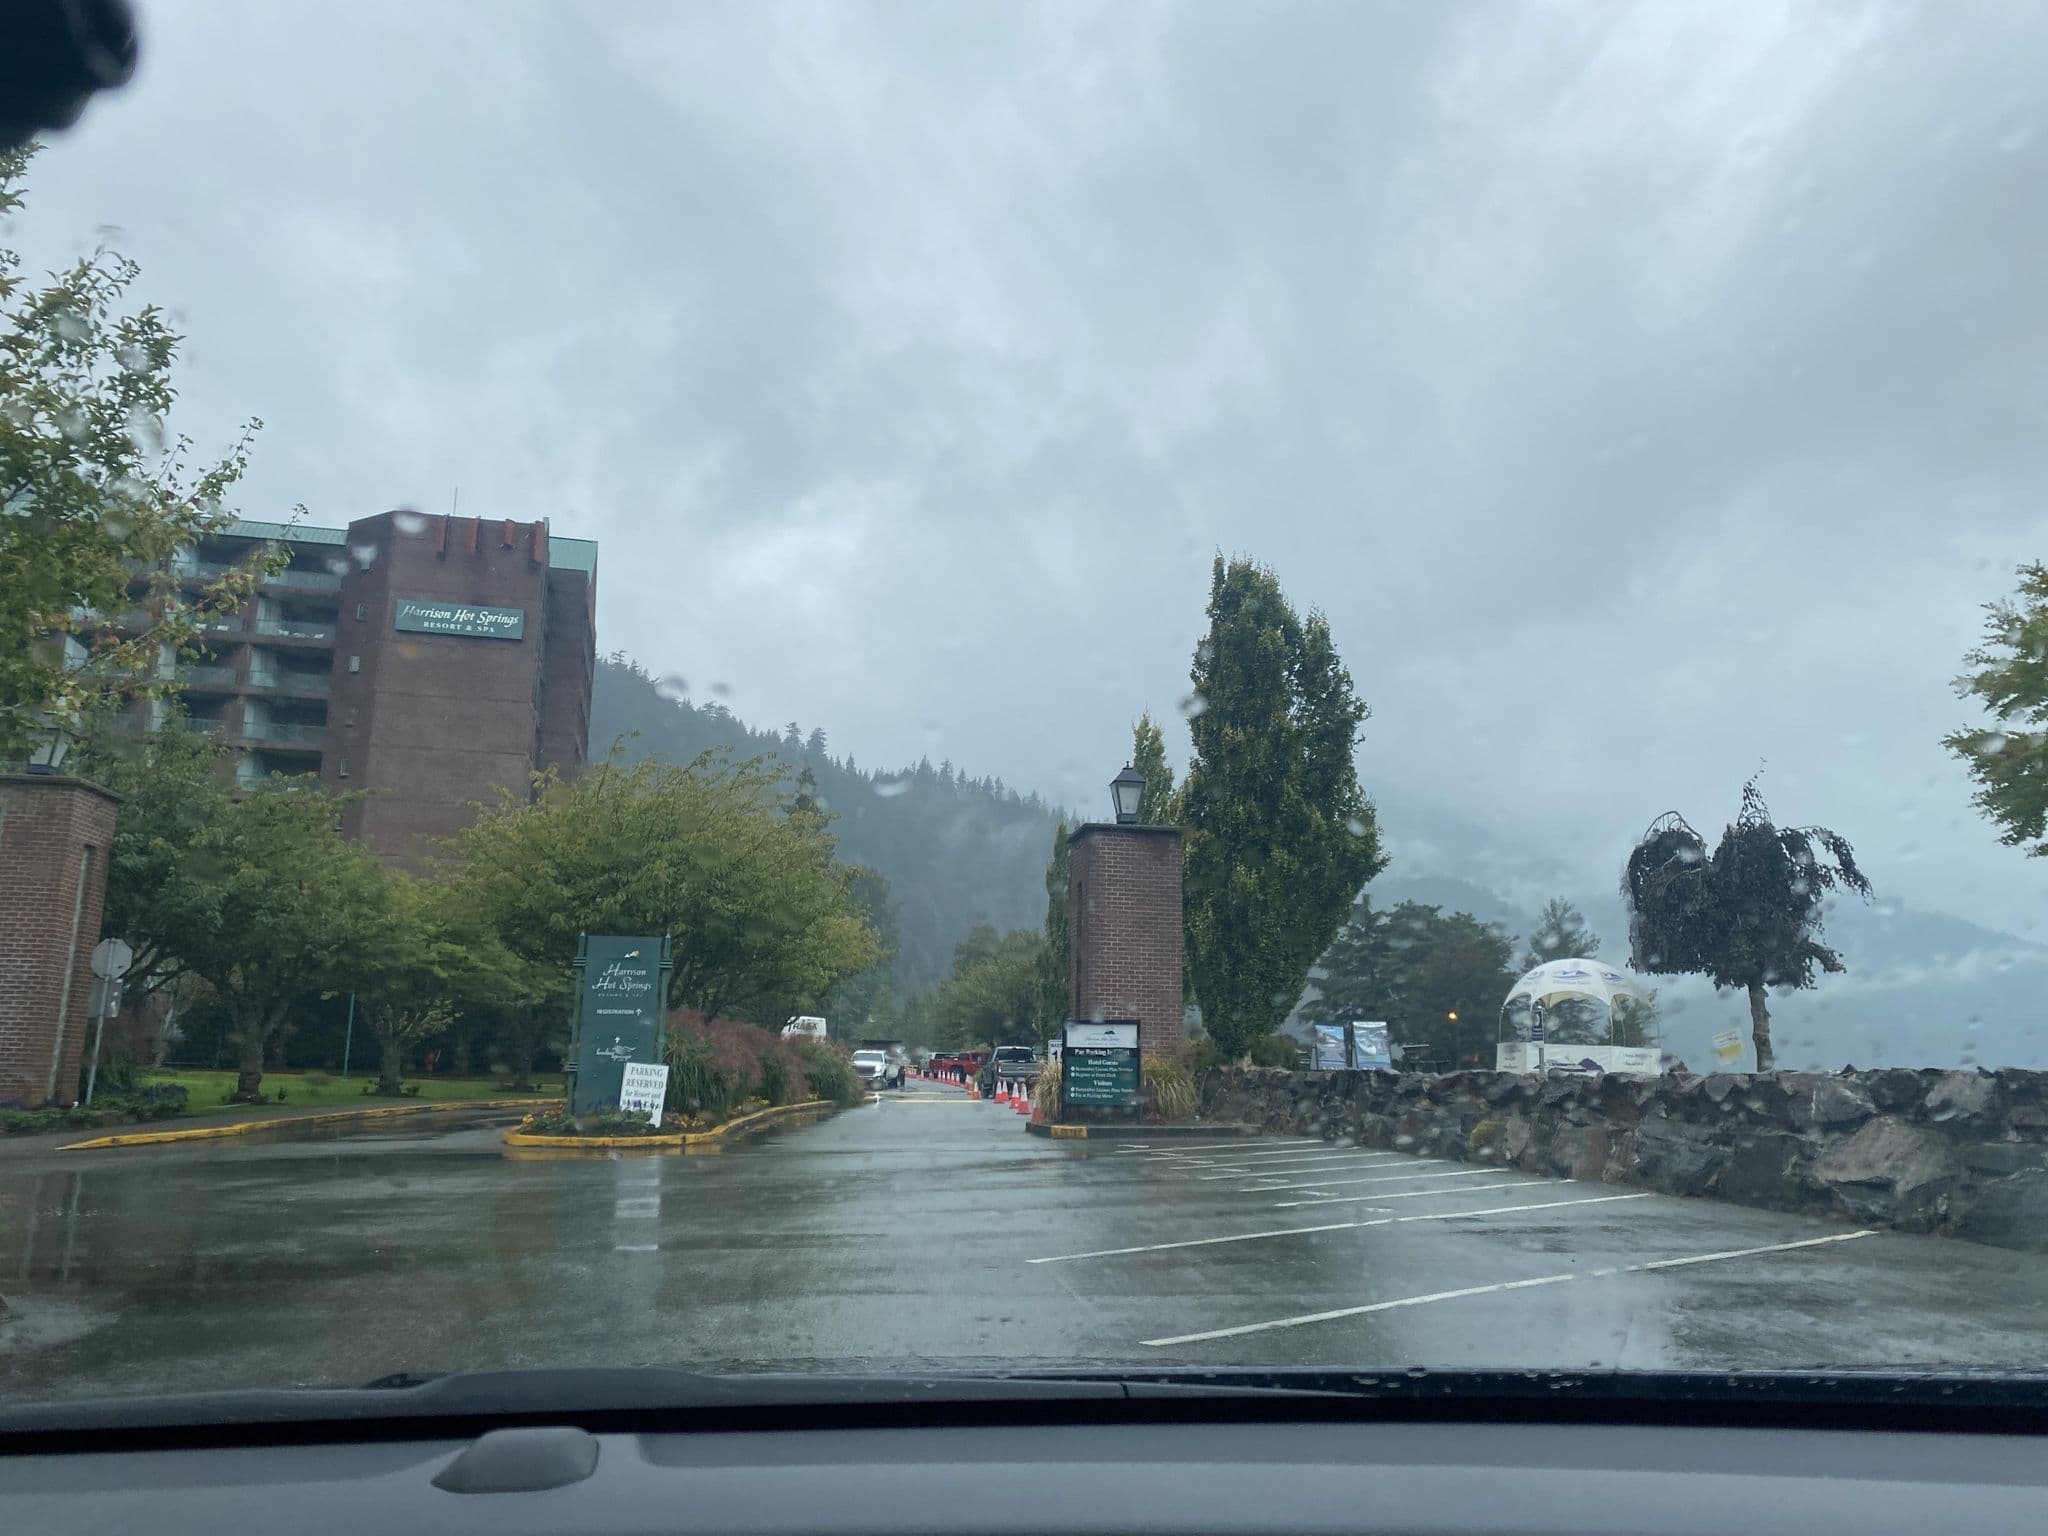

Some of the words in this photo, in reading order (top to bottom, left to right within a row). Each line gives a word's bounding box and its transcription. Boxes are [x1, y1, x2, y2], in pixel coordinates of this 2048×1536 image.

[401, 605, 451, 619] Harrison
[452, 609, 475, 622] Hot
[476, 611, 519, 628] Springs
[423, 621, 461, 630] RESORT
[603, 962, 646, 976] Harrison
[592, 976, 616, 990] Hot
[619, 976, 652, 991] Springs
[631, 1067, 662, 1076] PARKING
[625, 1079, 664, 1089] RESERVED
